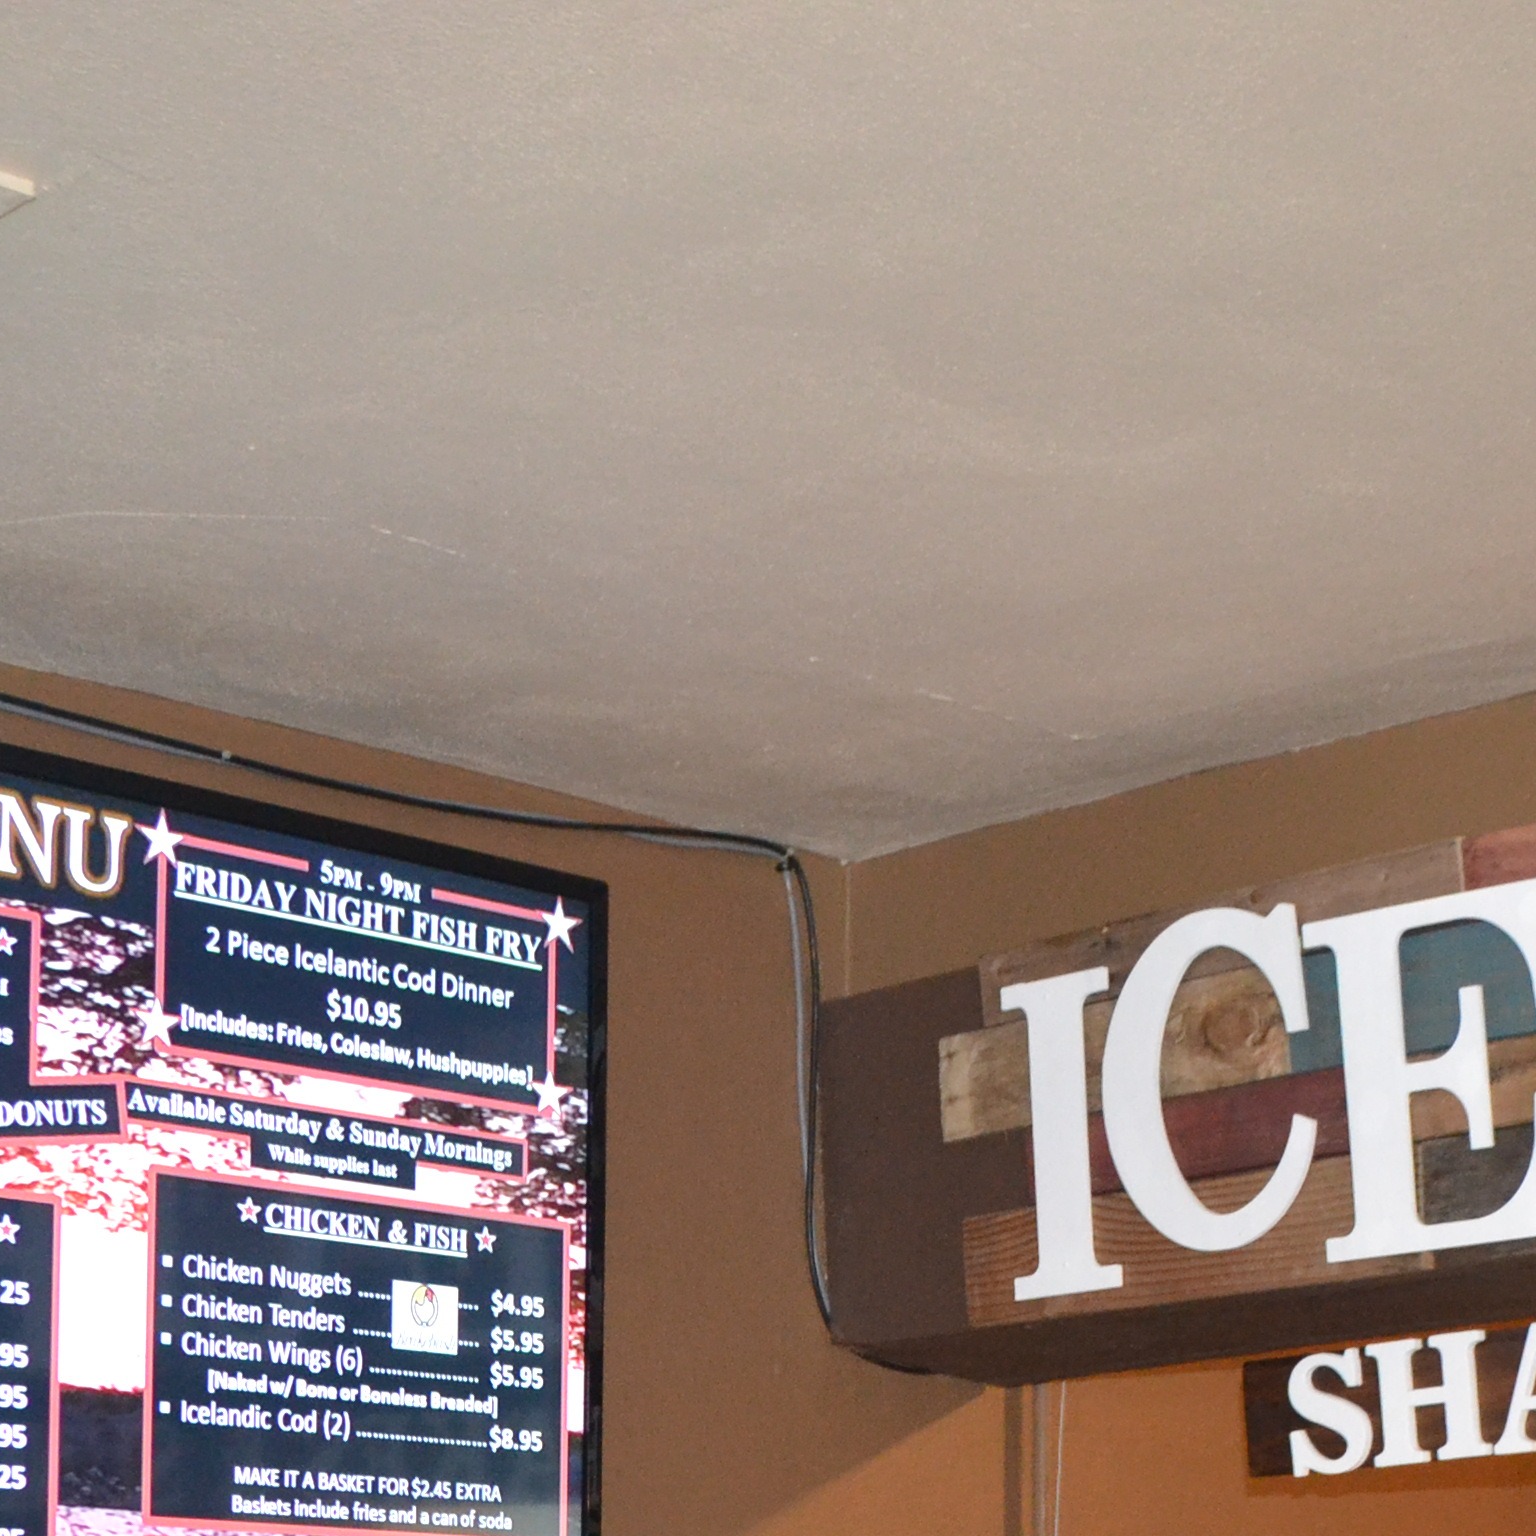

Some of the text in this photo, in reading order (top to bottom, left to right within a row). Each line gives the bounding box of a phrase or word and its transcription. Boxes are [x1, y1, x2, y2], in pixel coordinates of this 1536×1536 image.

[174, 863, 541, 965] FRIDAY NIGHT FISH FRY
[206, 926, 220, 953] 2
[228, 930, 289, 966] Piece
[393, 963, 436, 994] Cod
[442, 972, 514, 1009] Dinner
[327, 988, 401, 1029] $10.95
[264, 1205, 468, 1253] CHICKEN & FISH
[183, 1254, 544, 1318] Chicken Nuggets $4.95
